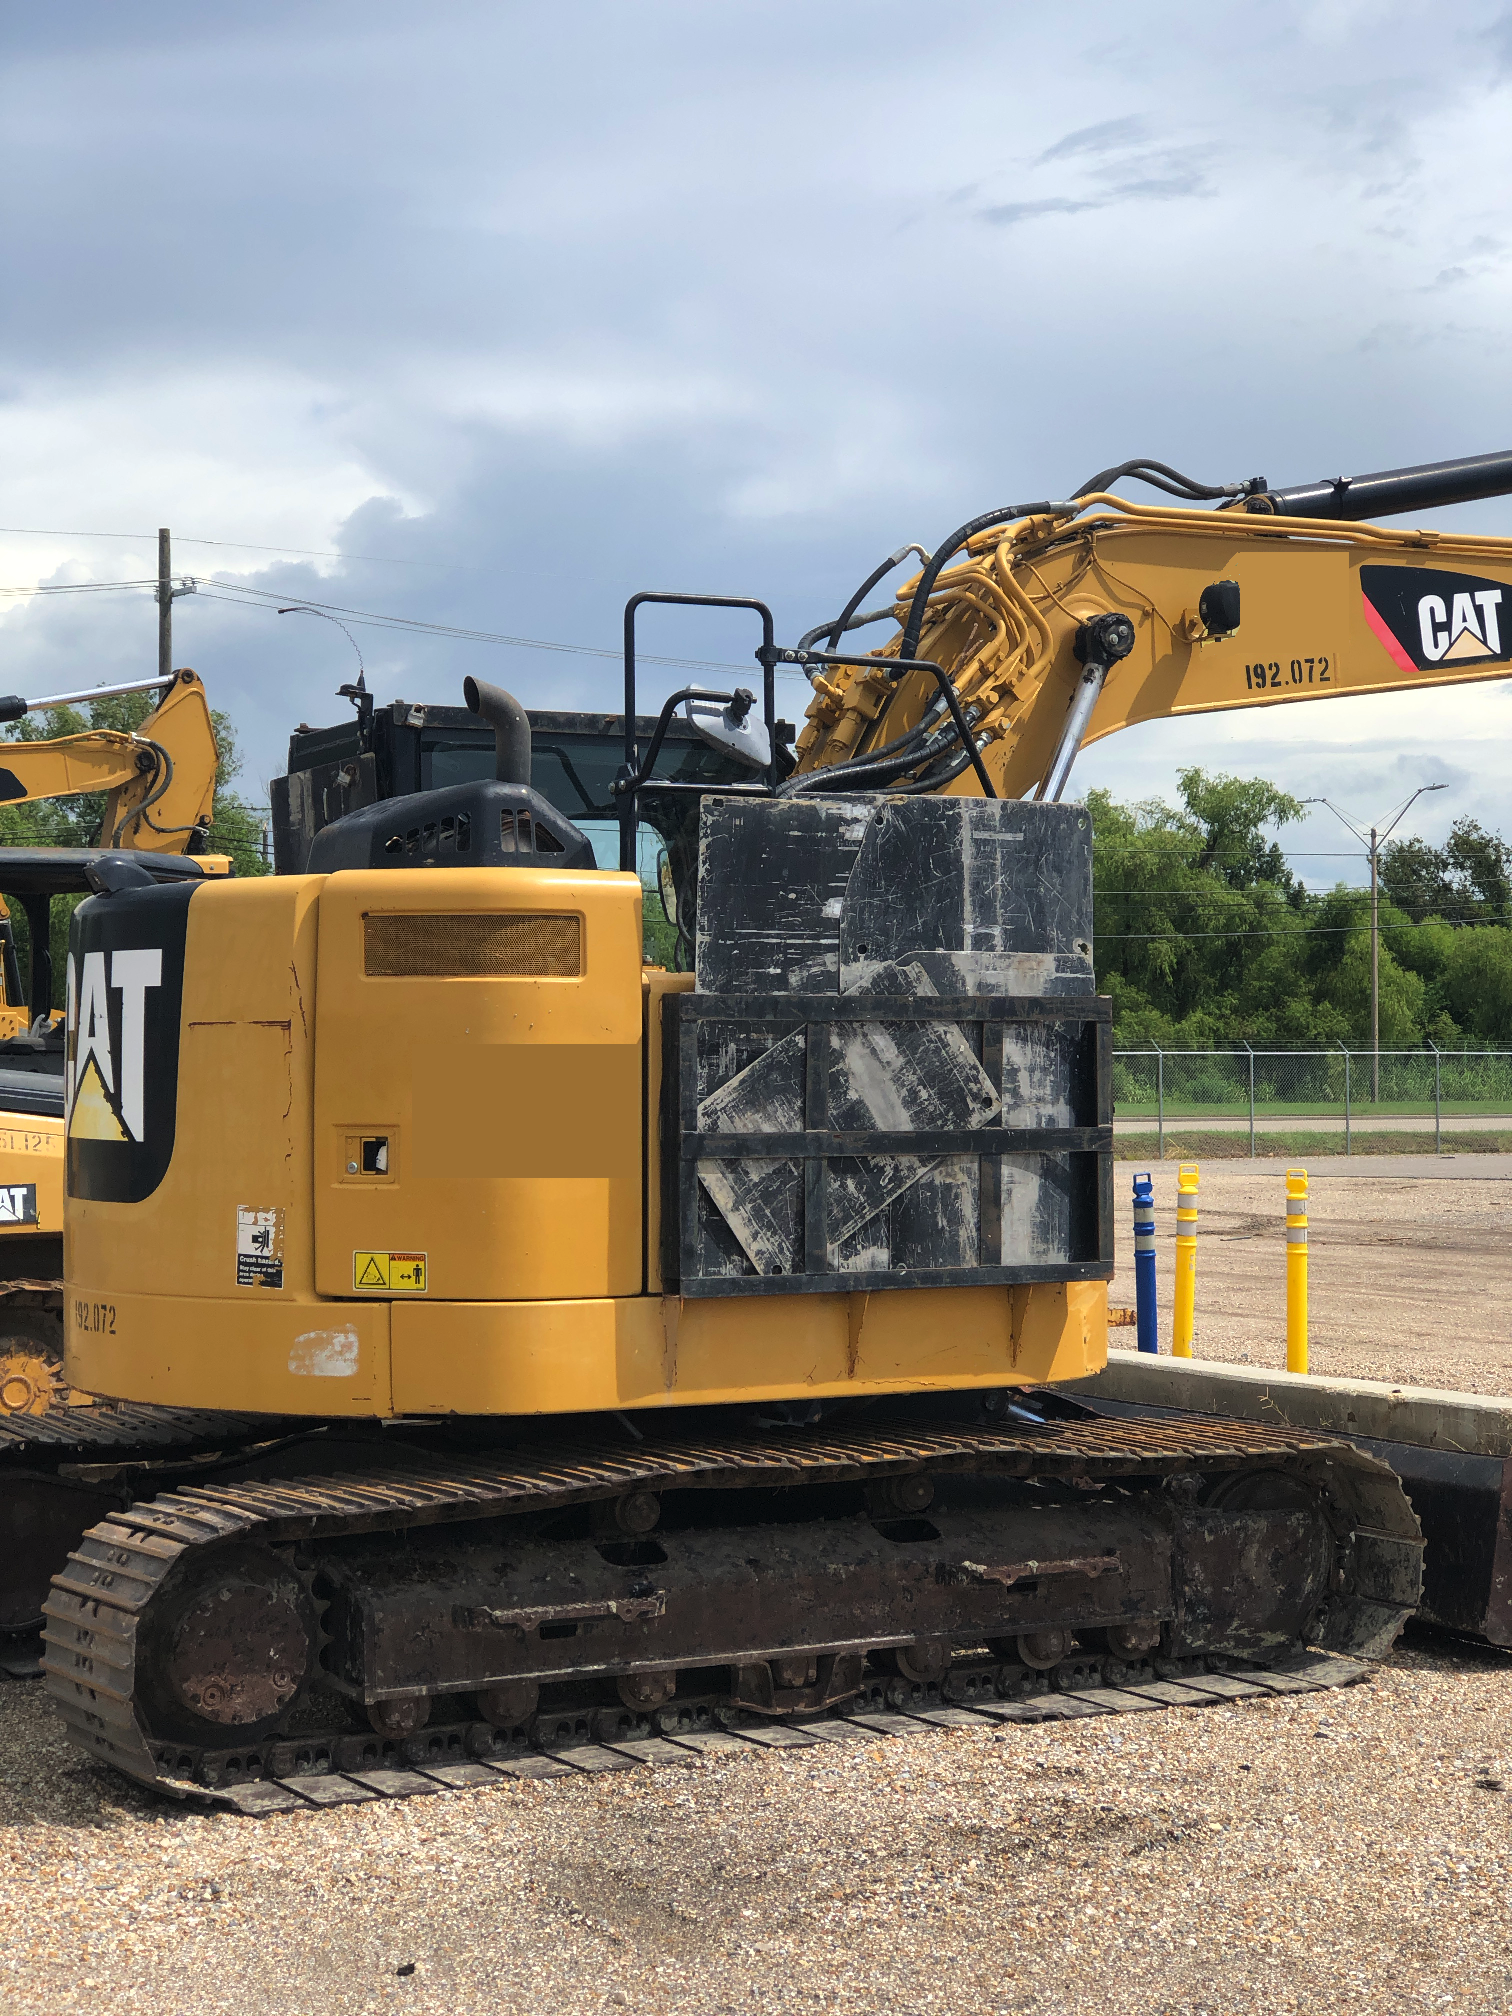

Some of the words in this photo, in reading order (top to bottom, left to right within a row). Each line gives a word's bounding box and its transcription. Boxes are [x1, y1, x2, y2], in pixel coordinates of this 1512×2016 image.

[1418, 589, 1503, 661] CAT
[1245, 656, 1321, 690] 192.072
[0, 1187, 27, 1220] AT
[239, 1255, 257, 1263] Crush
[75, 1300, 117, 1335] 192.072
